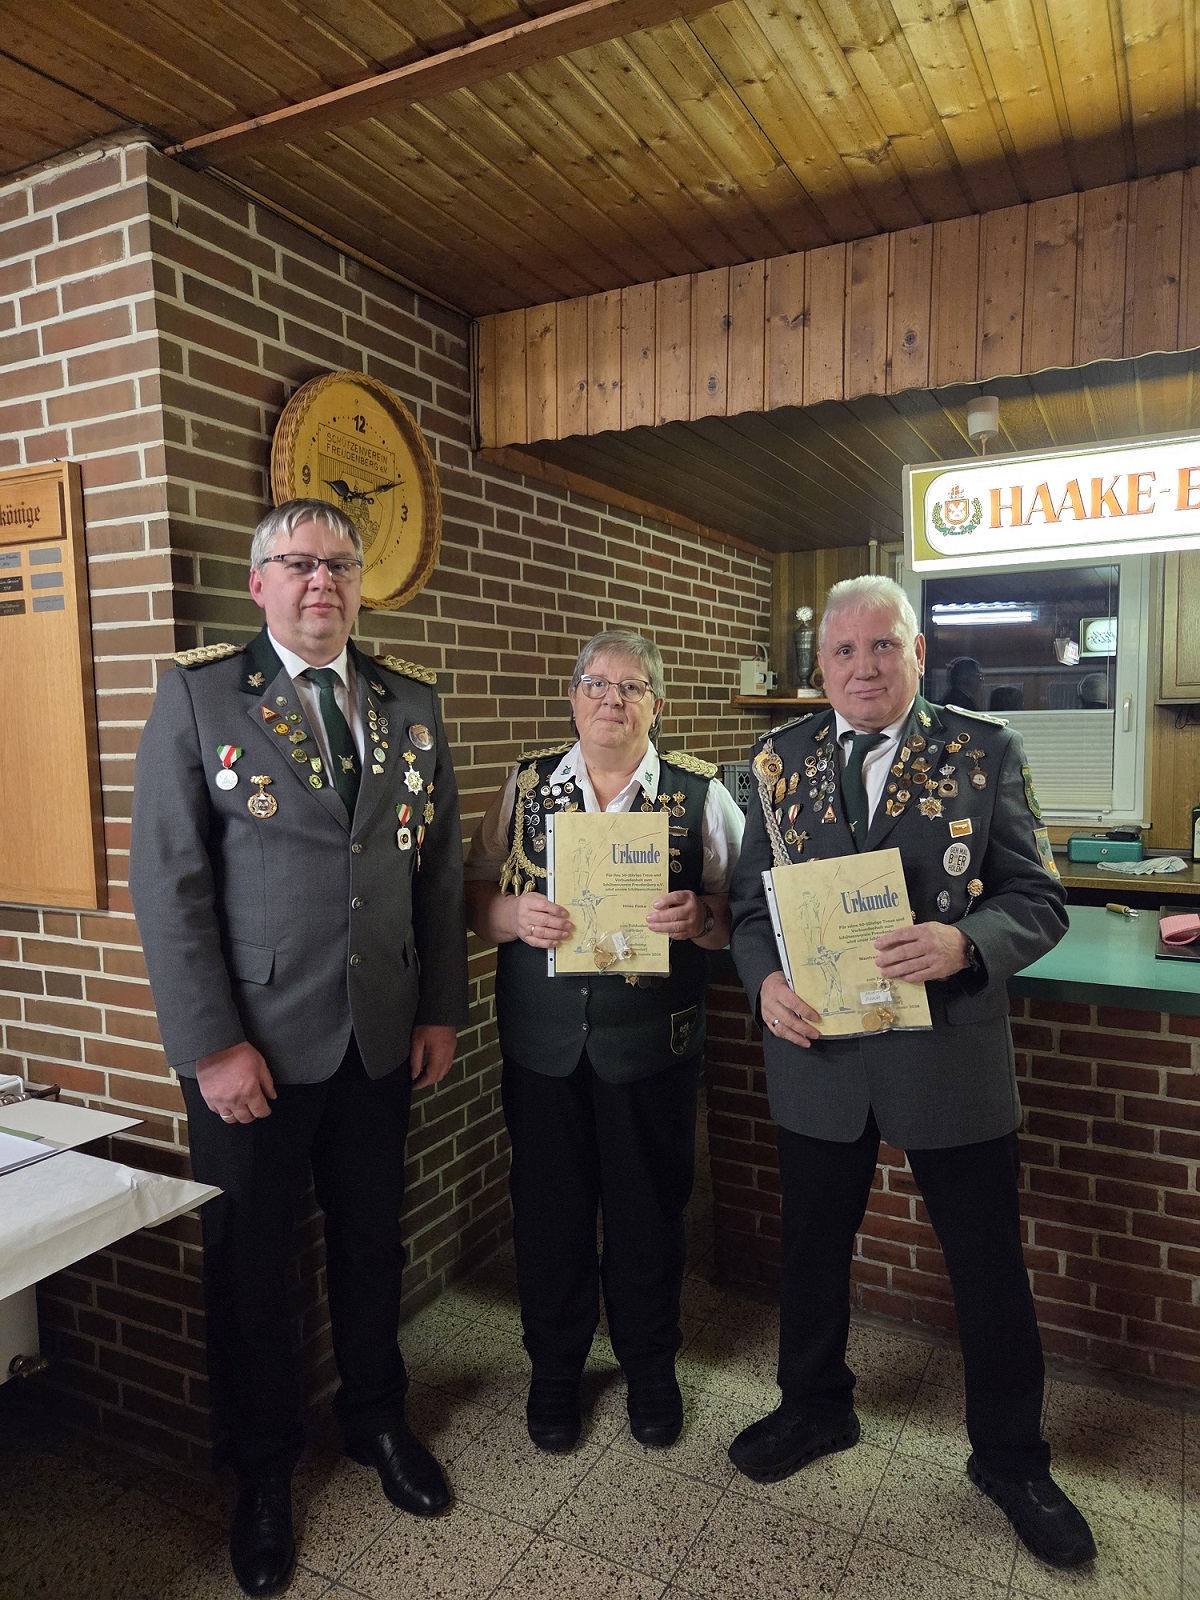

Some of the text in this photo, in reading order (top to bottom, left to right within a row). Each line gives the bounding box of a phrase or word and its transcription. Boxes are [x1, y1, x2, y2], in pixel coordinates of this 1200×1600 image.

[354, 414, 366, 434] 12
[326, 432, 388, 464] SCHÜTZENVEREIN
[326, 443, 379, 471] FREUDENBERG
[302, 464, 311, 484] 9
[401, 502, 409, 522] 3
[611, 842, 661, 865] Urkunde
[839, 884, 900, 915] Urkunde
